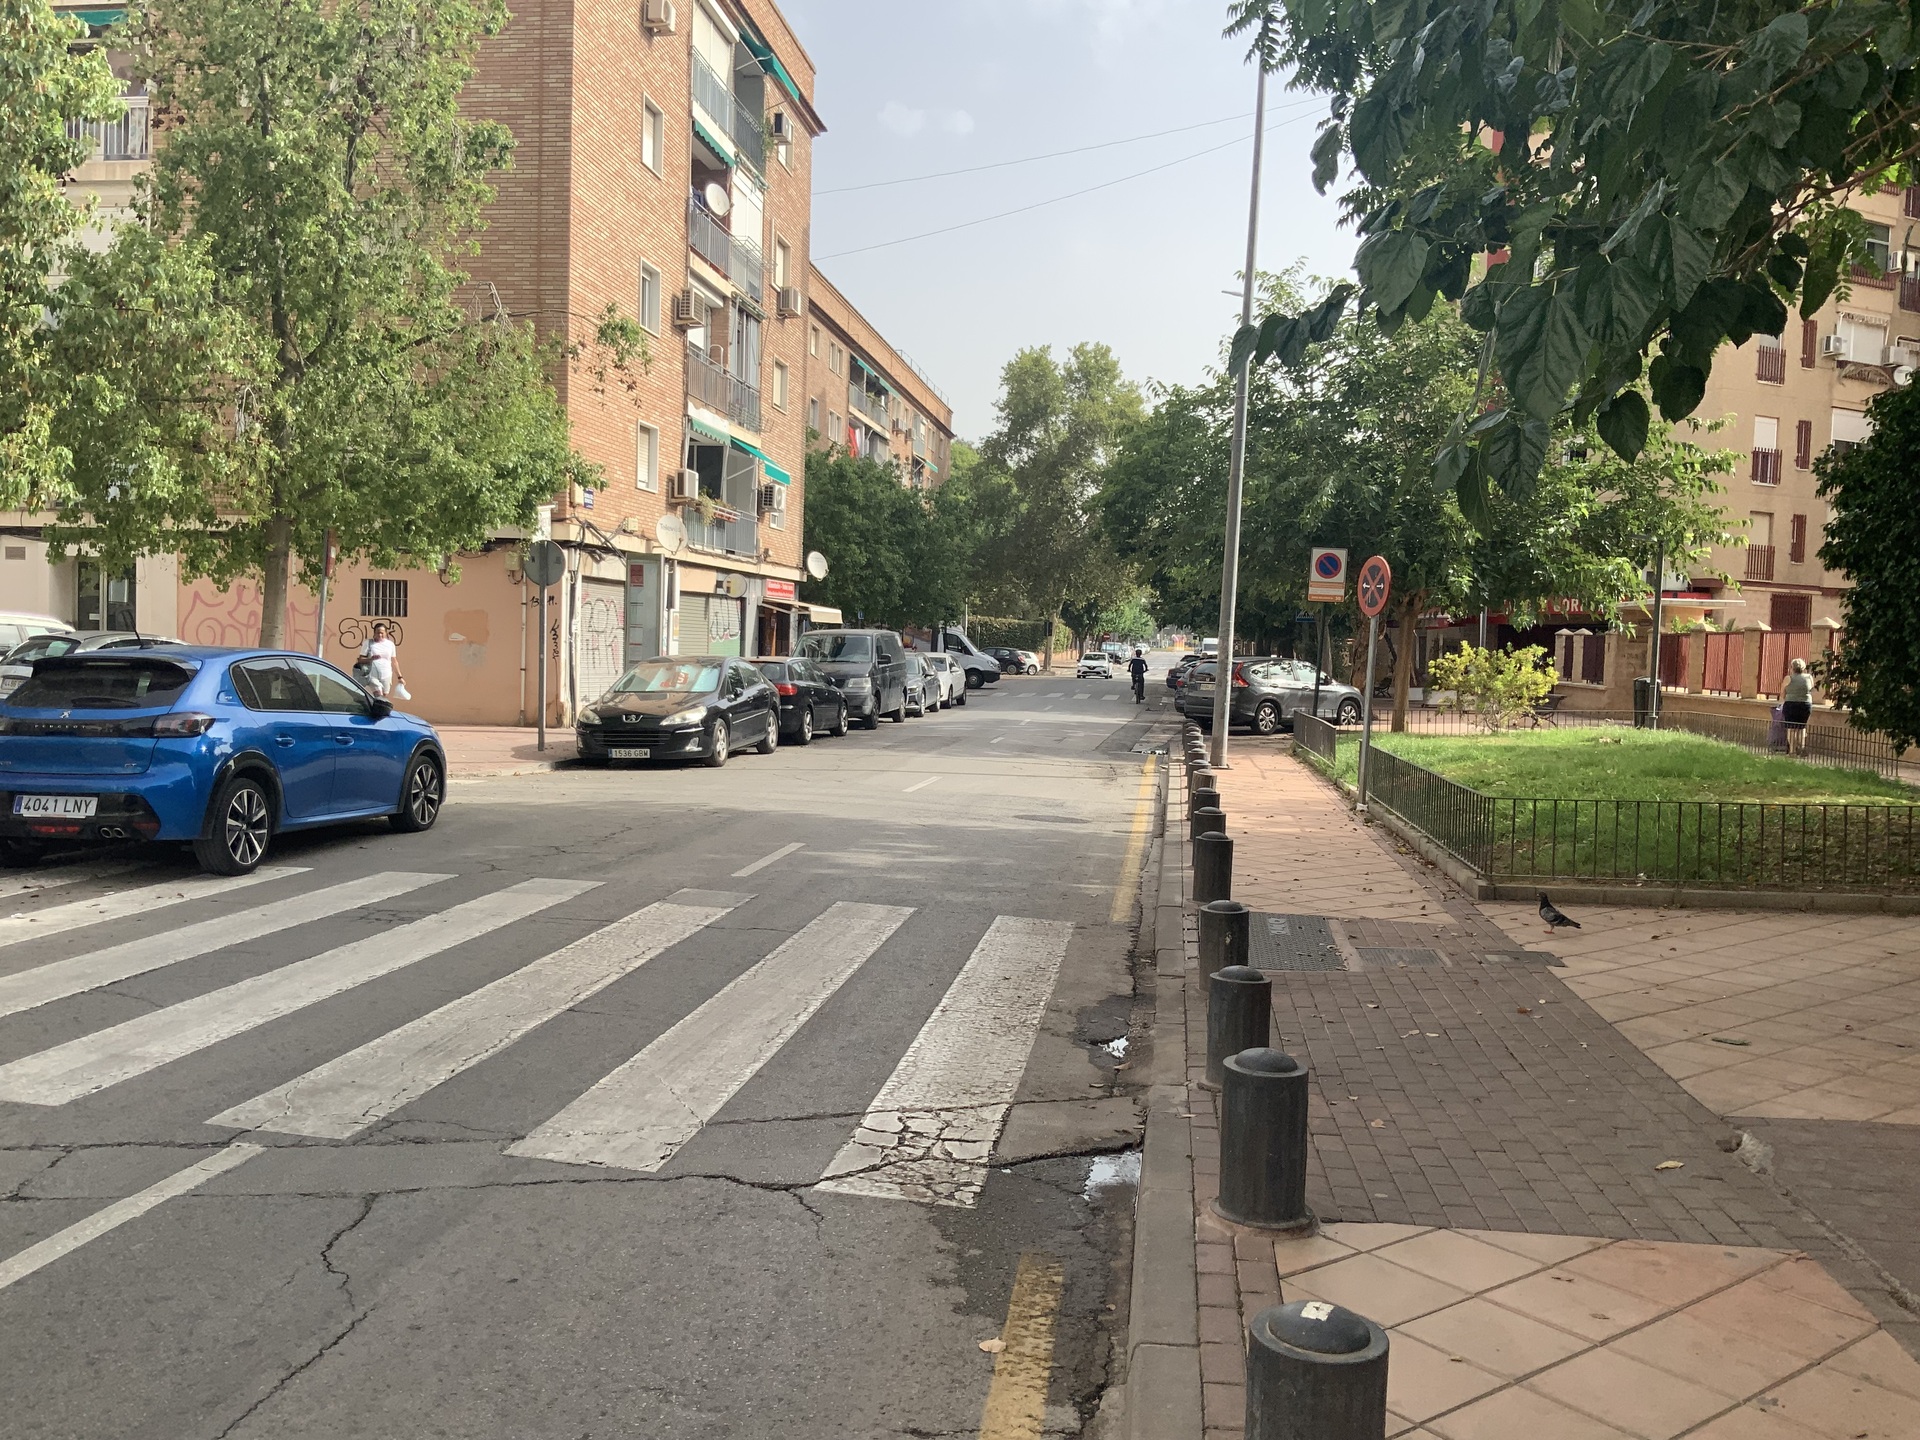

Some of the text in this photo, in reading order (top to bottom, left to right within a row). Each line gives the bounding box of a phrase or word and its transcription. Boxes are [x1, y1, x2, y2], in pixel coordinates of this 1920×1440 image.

[614, 749, 632, 757] 1536
[23, 797, 92, 813] 4041 LNY
